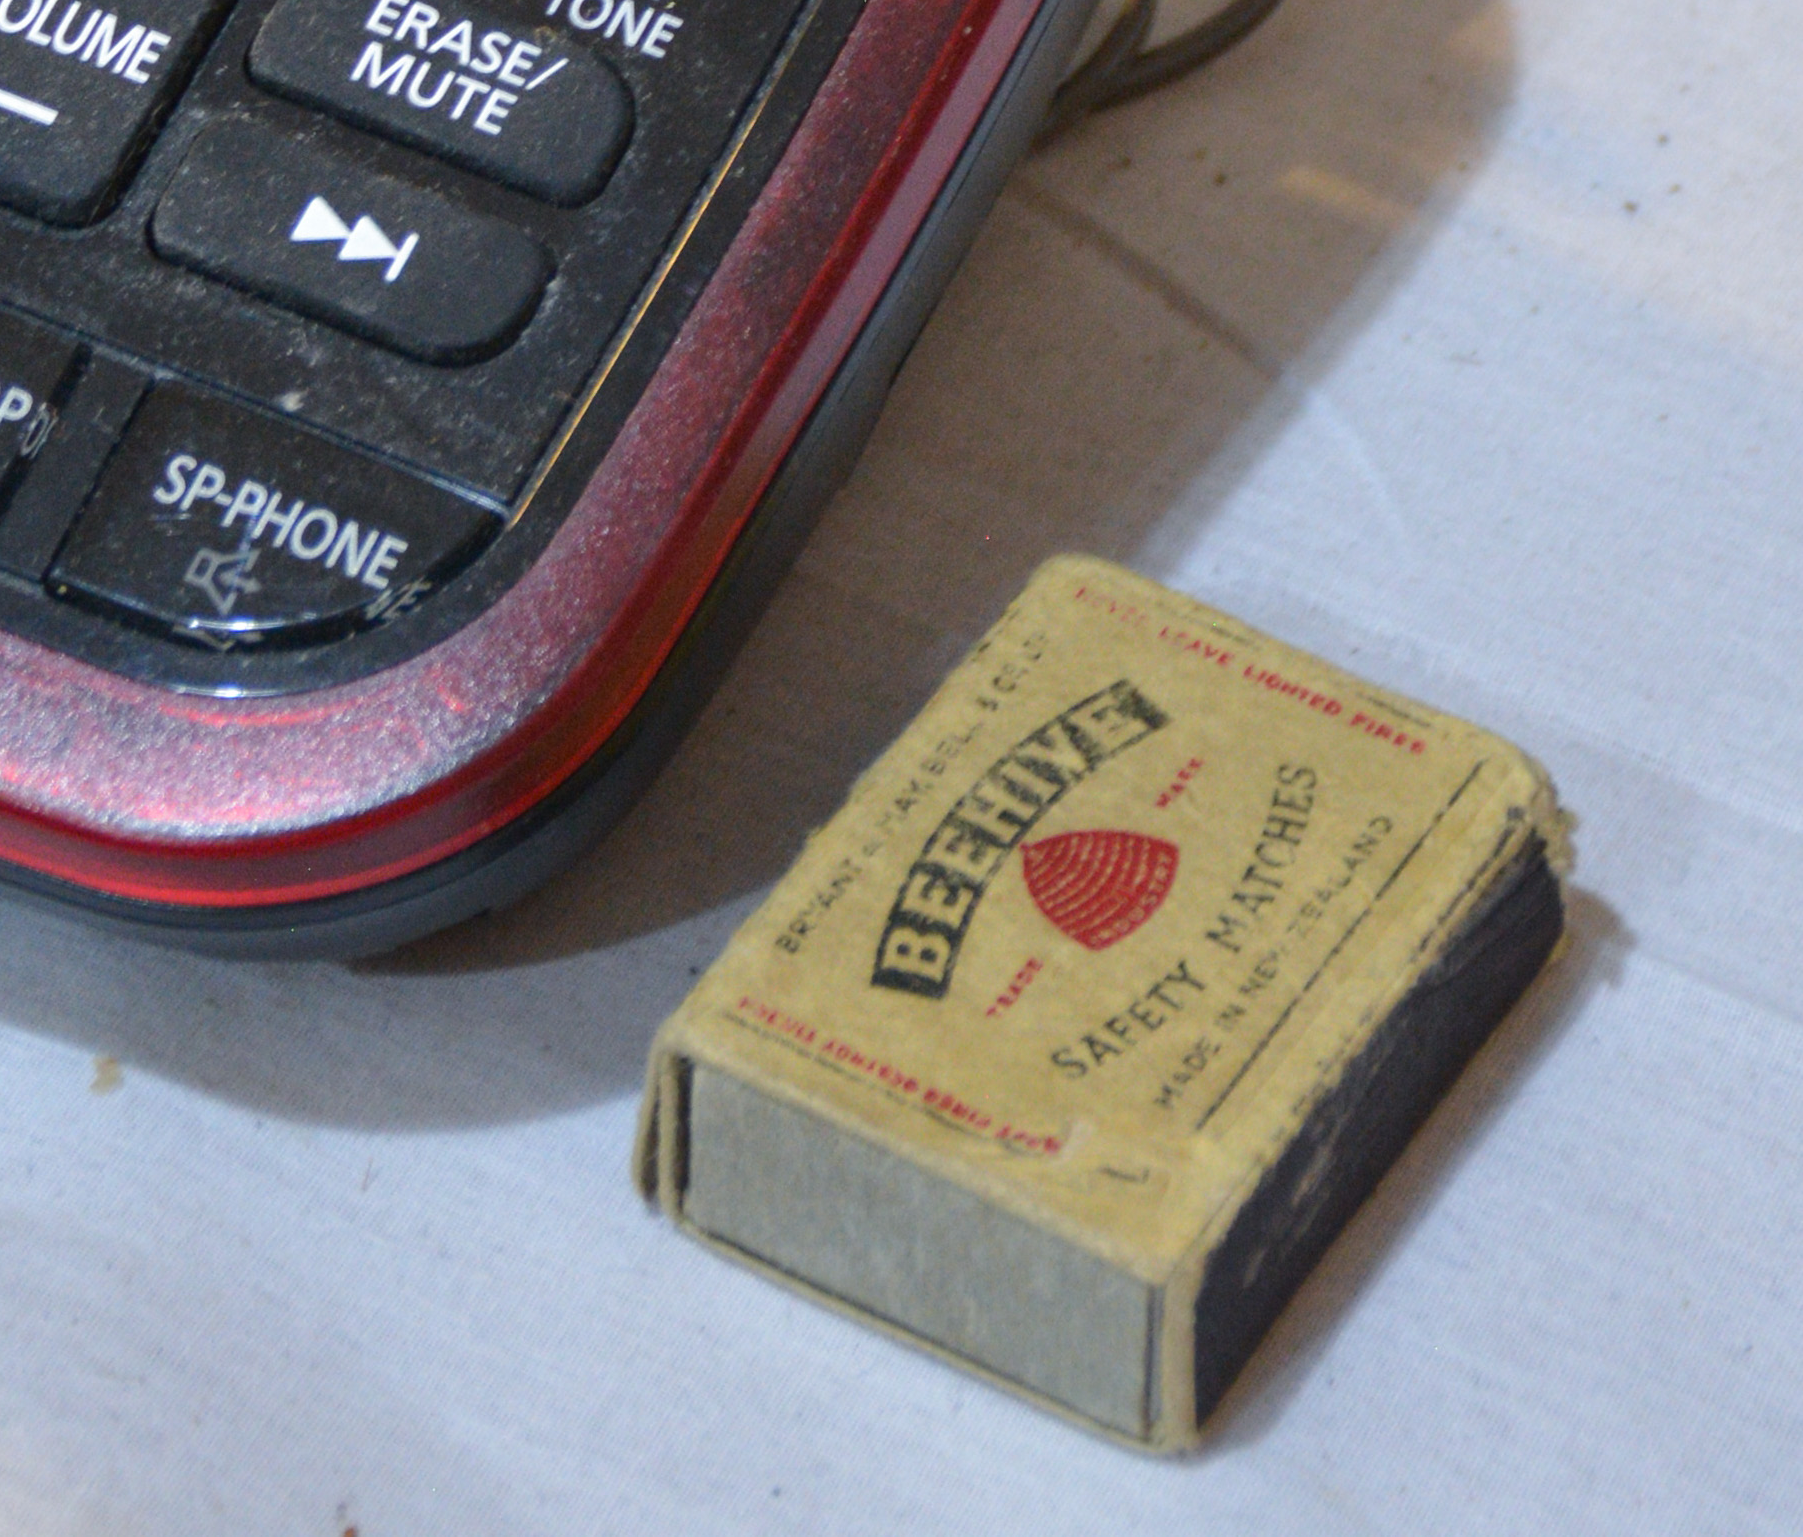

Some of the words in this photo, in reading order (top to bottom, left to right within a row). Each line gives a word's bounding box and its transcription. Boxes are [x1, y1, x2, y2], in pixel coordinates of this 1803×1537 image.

[349, 43, 518, 136] MUTE
[153, 453, 409, 590] SP-PHONE
[878, 687, 1152, 985] BEEHIVE
[1050, 958, 1207, 1080] SAFETY
[1204, 762, 1319, 955] MATCHES
[1152, 1034, 1223, 1111] MADE
[1285, 814, 1394, 937] ZEALAND
